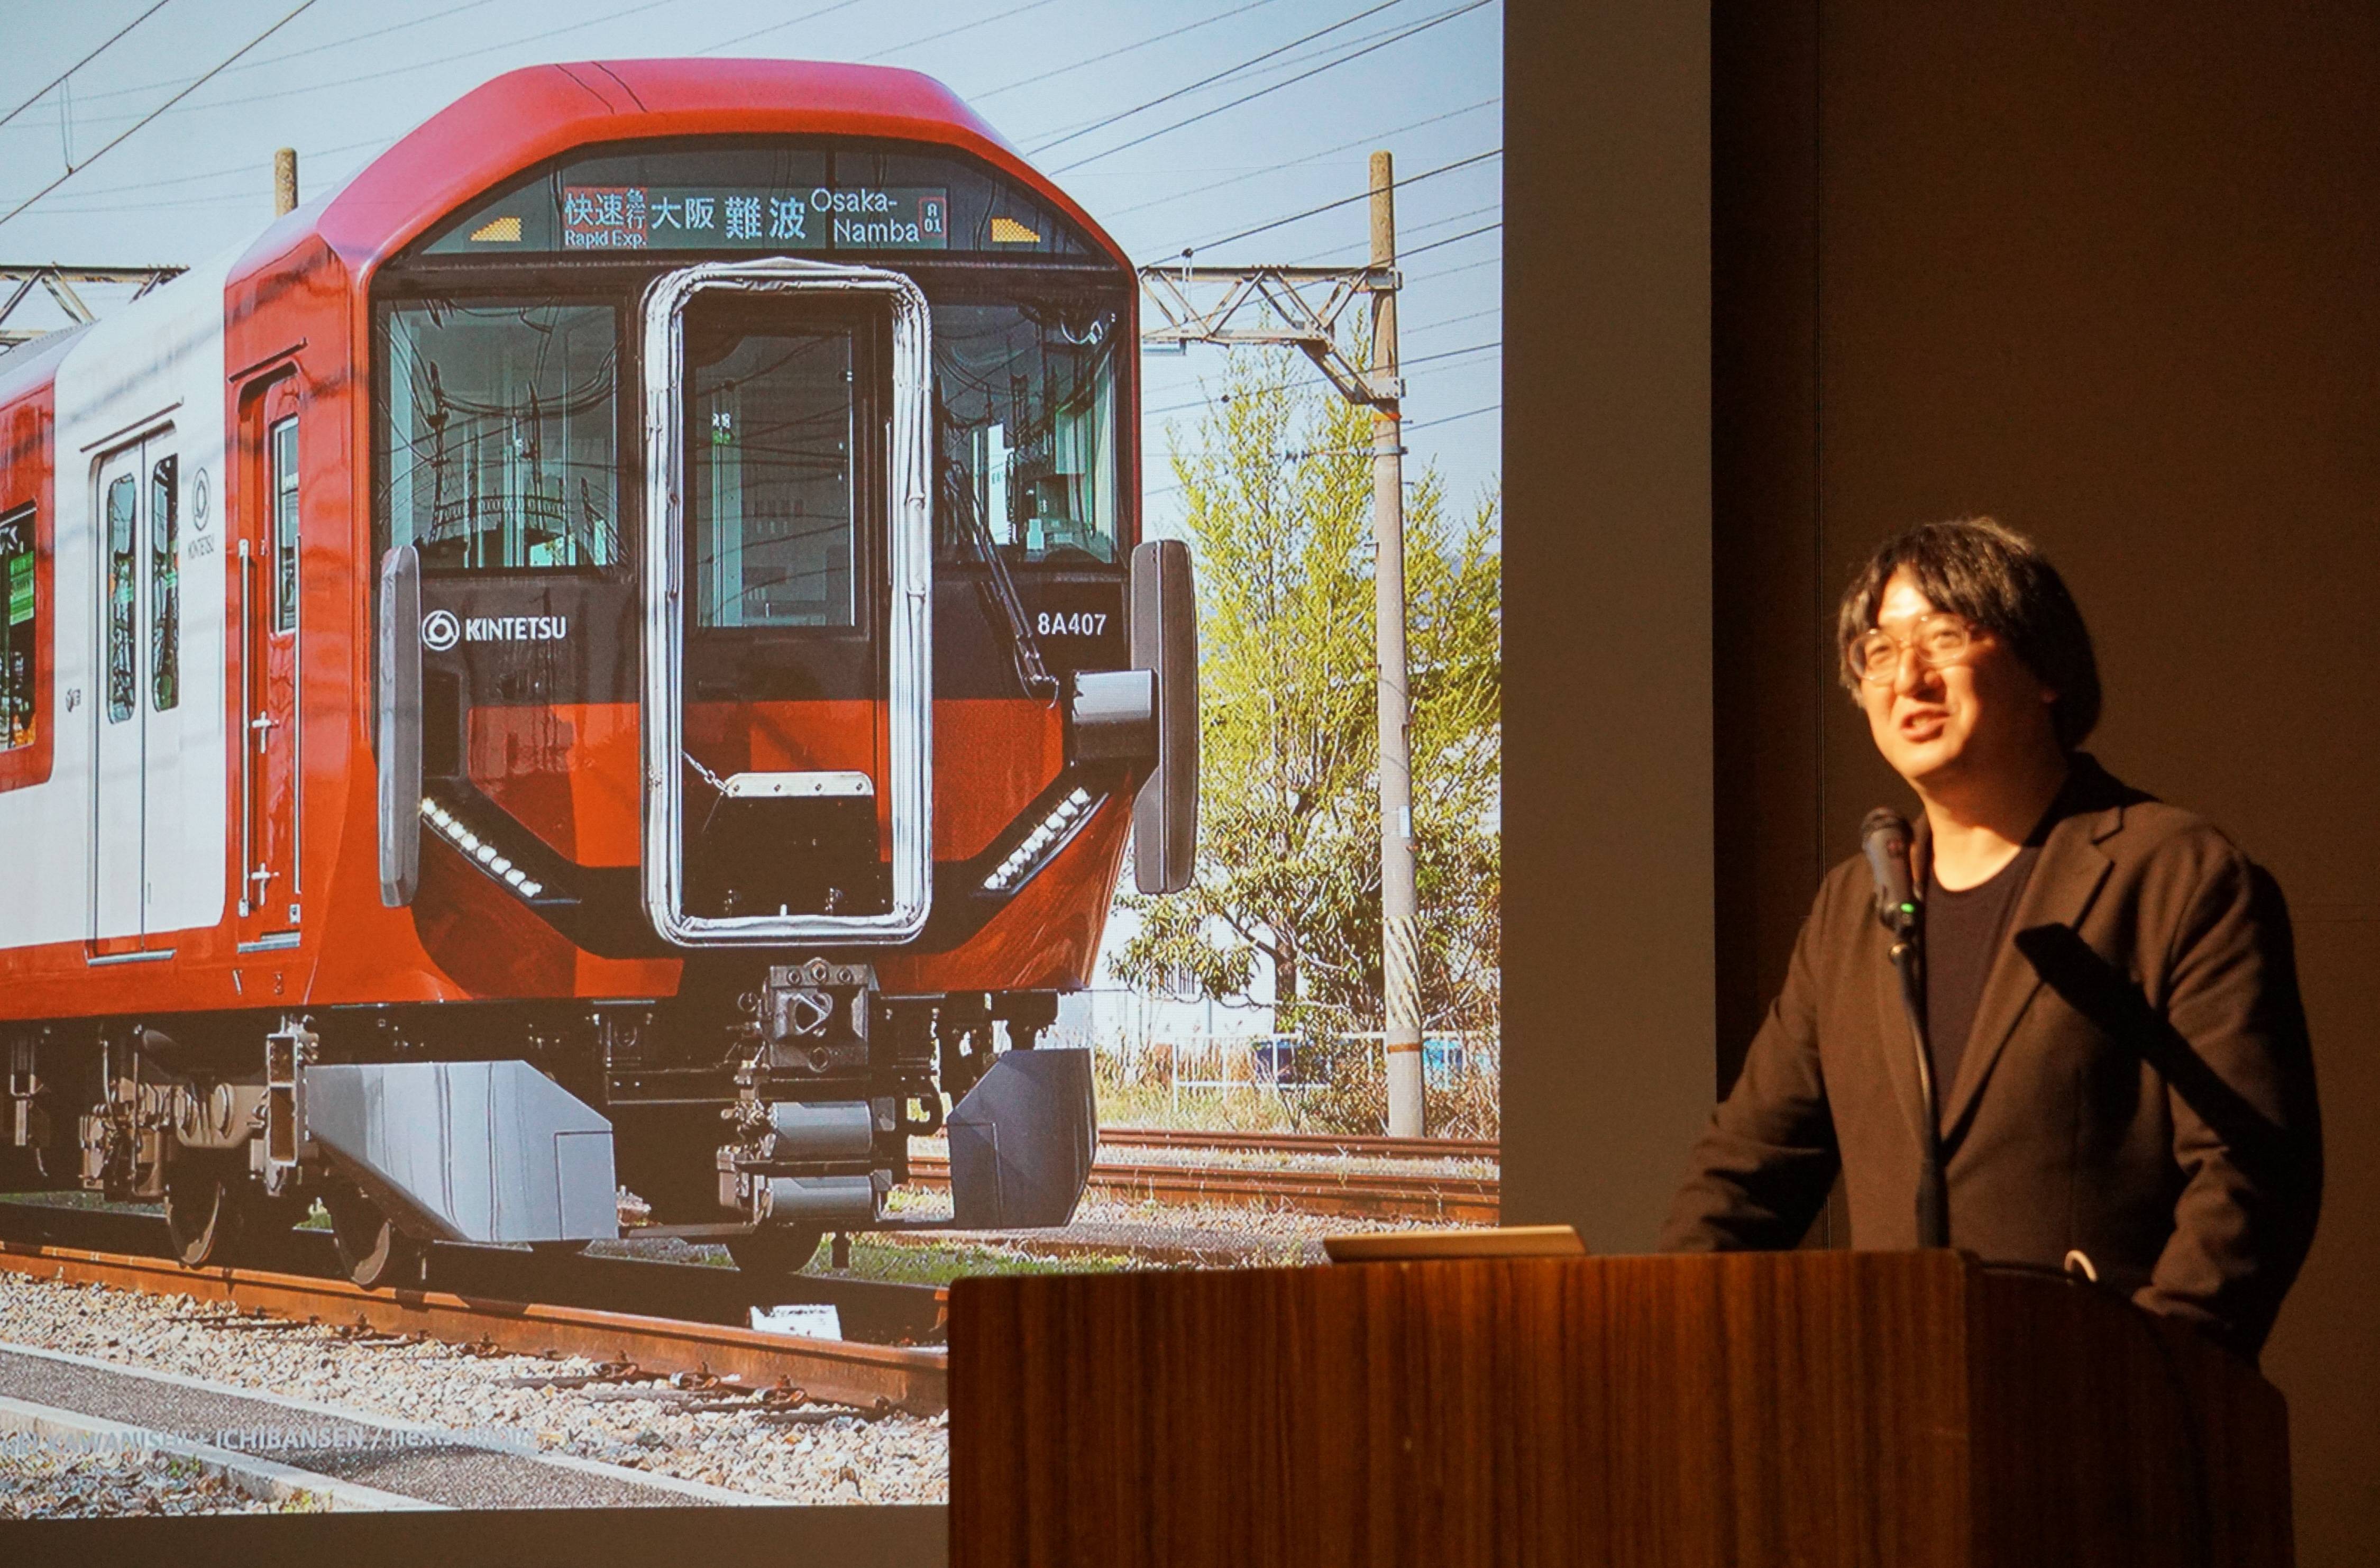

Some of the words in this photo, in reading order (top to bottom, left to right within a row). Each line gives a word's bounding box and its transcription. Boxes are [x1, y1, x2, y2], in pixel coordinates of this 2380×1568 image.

[811, 188, 898, 212] Osaka-
[651, 196, 807, 239] 大阪難波
[924, 218, 942, 233] 01
[564, 229, 608, 249] Rapid
[612, 229, 647, 249] Exp.
[834, 218, 920, 243] Namba
[465, 616, 567, 641] KINTETSU
[1037, 612, 1107, 635] 8A407
